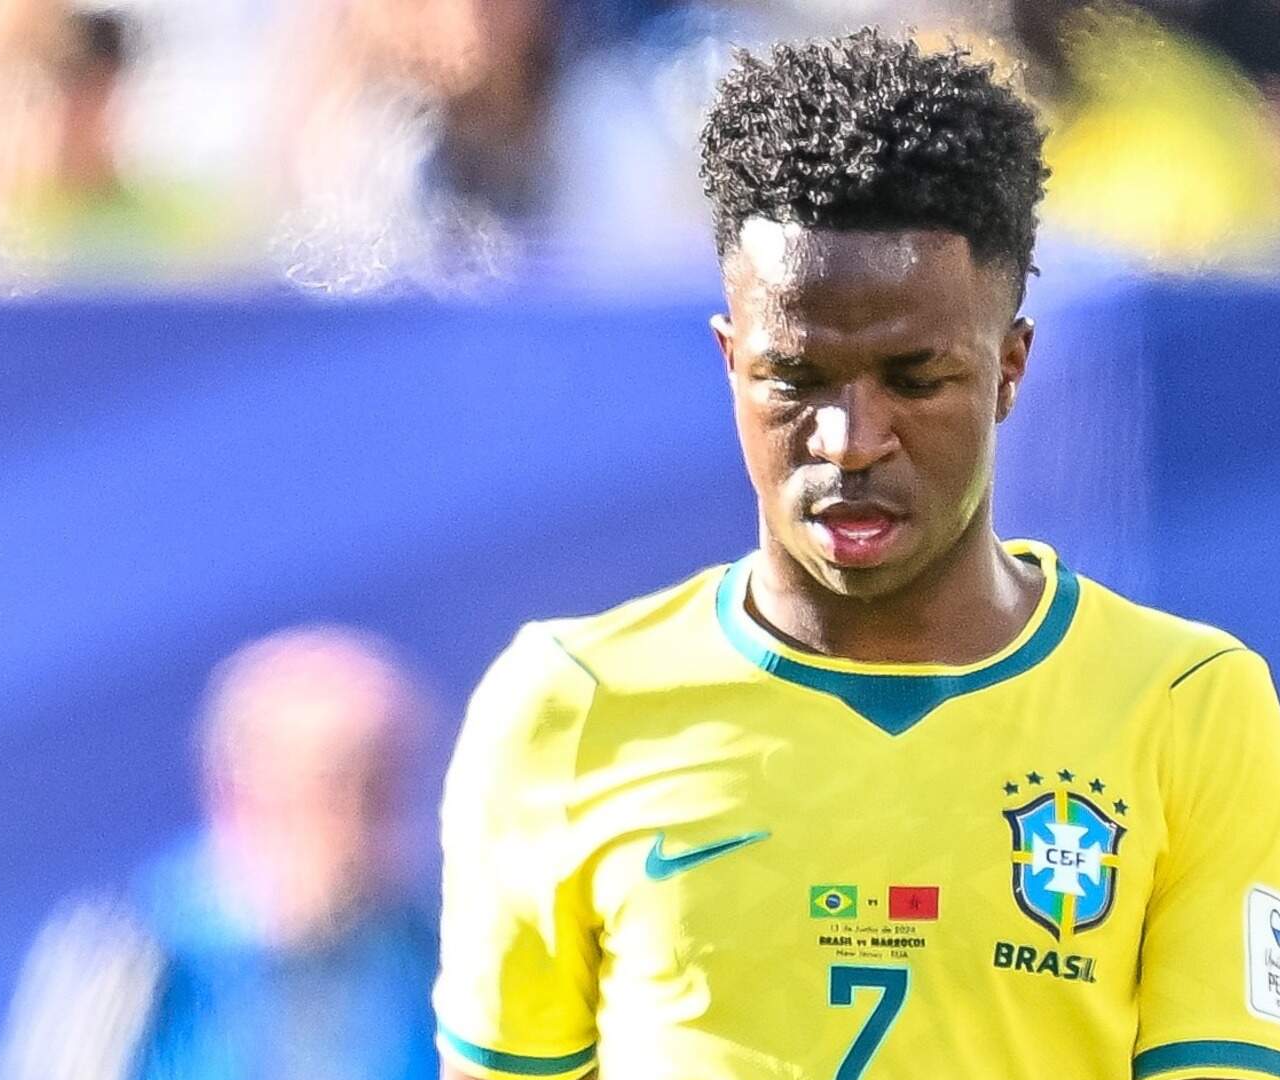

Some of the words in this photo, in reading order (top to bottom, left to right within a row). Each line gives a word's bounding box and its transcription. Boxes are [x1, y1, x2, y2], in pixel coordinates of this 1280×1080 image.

[819, 936, 852, 946] BRASIL
[871, 937, 926, 948] MARROCOS
[993, 942, 1096, 983] BRASIL
